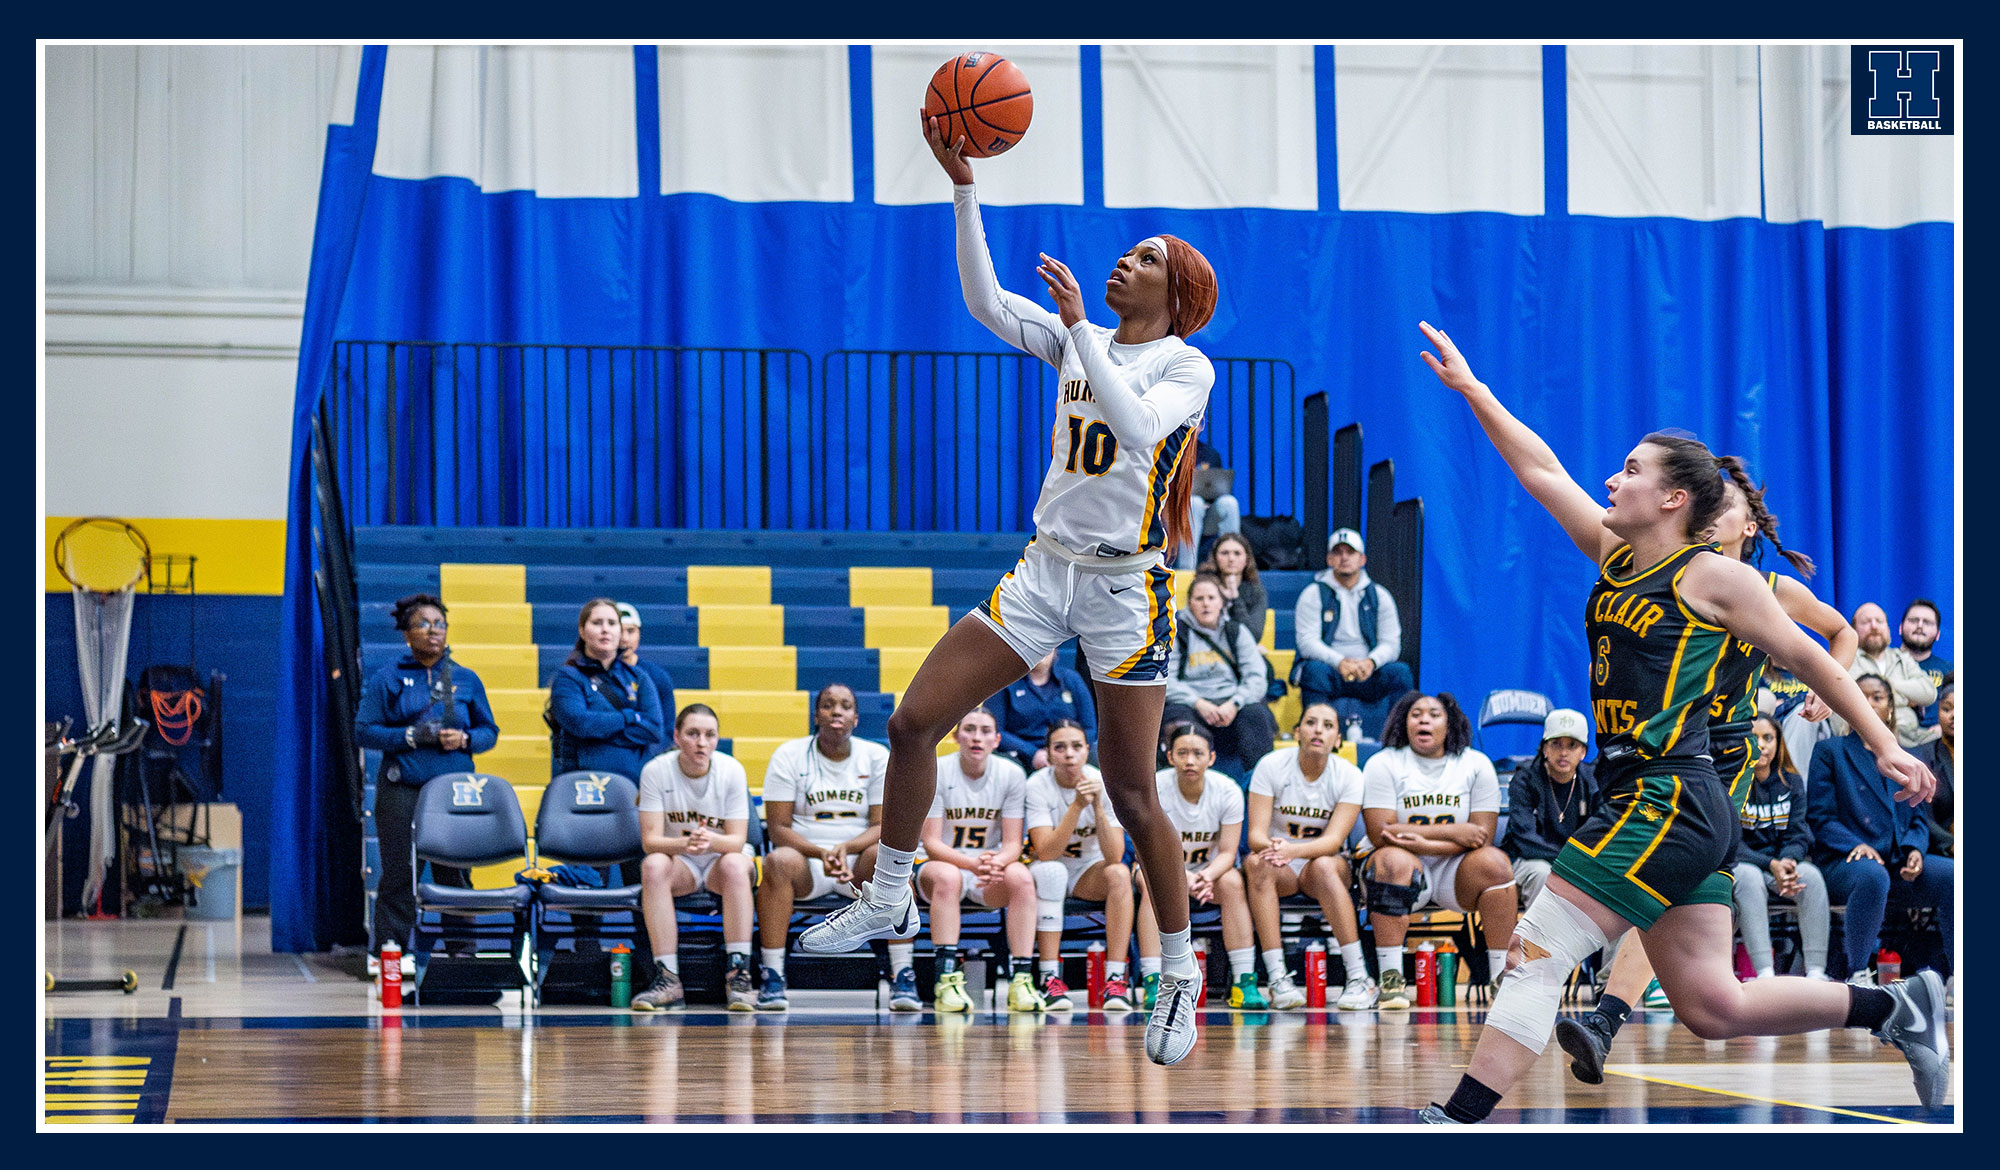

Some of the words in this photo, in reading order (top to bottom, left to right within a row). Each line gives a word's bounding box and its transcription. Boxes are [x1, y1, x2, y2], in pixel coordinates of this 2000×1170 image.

[1064, 413, 1119, 477] 10
[1594, 590, 1665, 639] CLAIR
[1595, 635, 1611, 687] 6
[805, 789, 864, 806] HUMBER
[1403, 793, 1461, 809] HUMBER
[952, 825, 988, 849] 15
